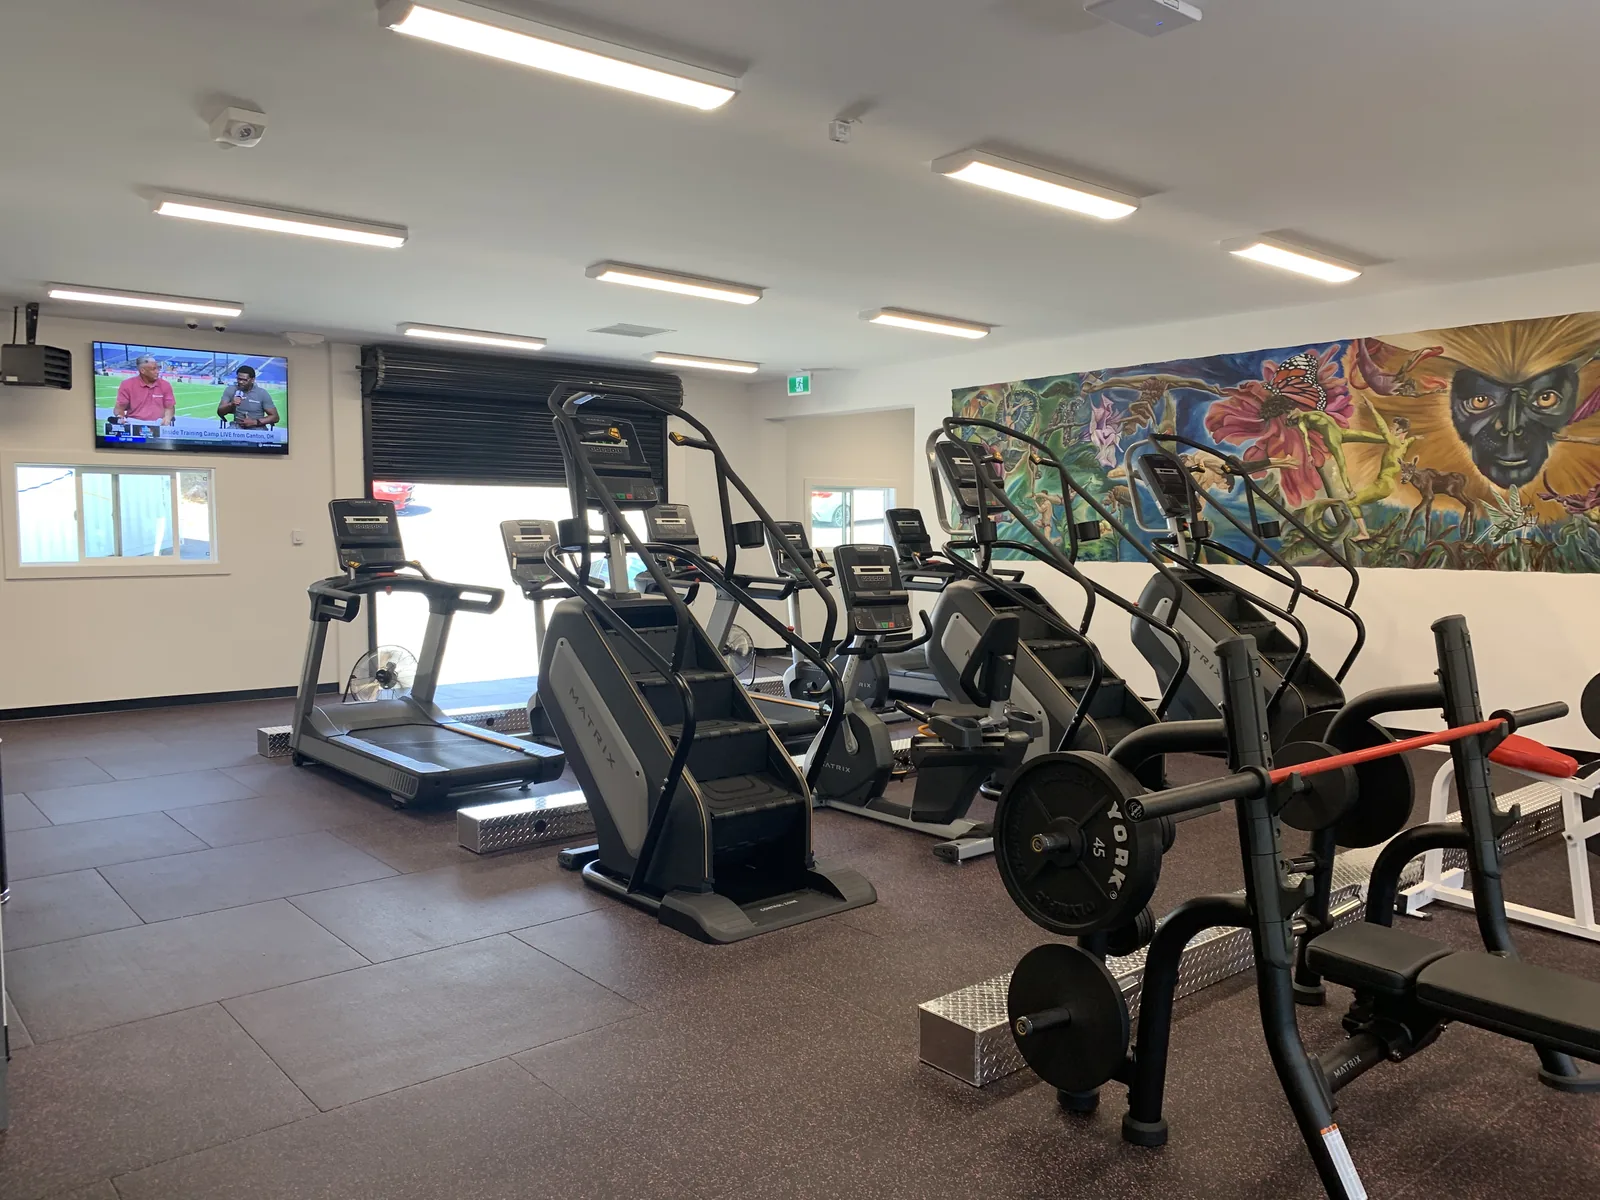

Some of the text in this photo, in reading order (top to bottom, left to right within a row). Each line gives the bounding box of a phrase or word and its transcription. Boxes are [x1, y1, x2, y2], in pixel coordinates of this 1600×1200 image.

[180, 430, 203, 438] Training
[1186, 640, 1221, 679] ATRIX
[858, 682, 872, 690] RIX
[569, 687, 616, 771] MATRIX
[822, 761, 852, 774] ATRIX
[1093, 836, 1106, 858] 45
[1333, 1054, 1362, 1079] MATRIX
